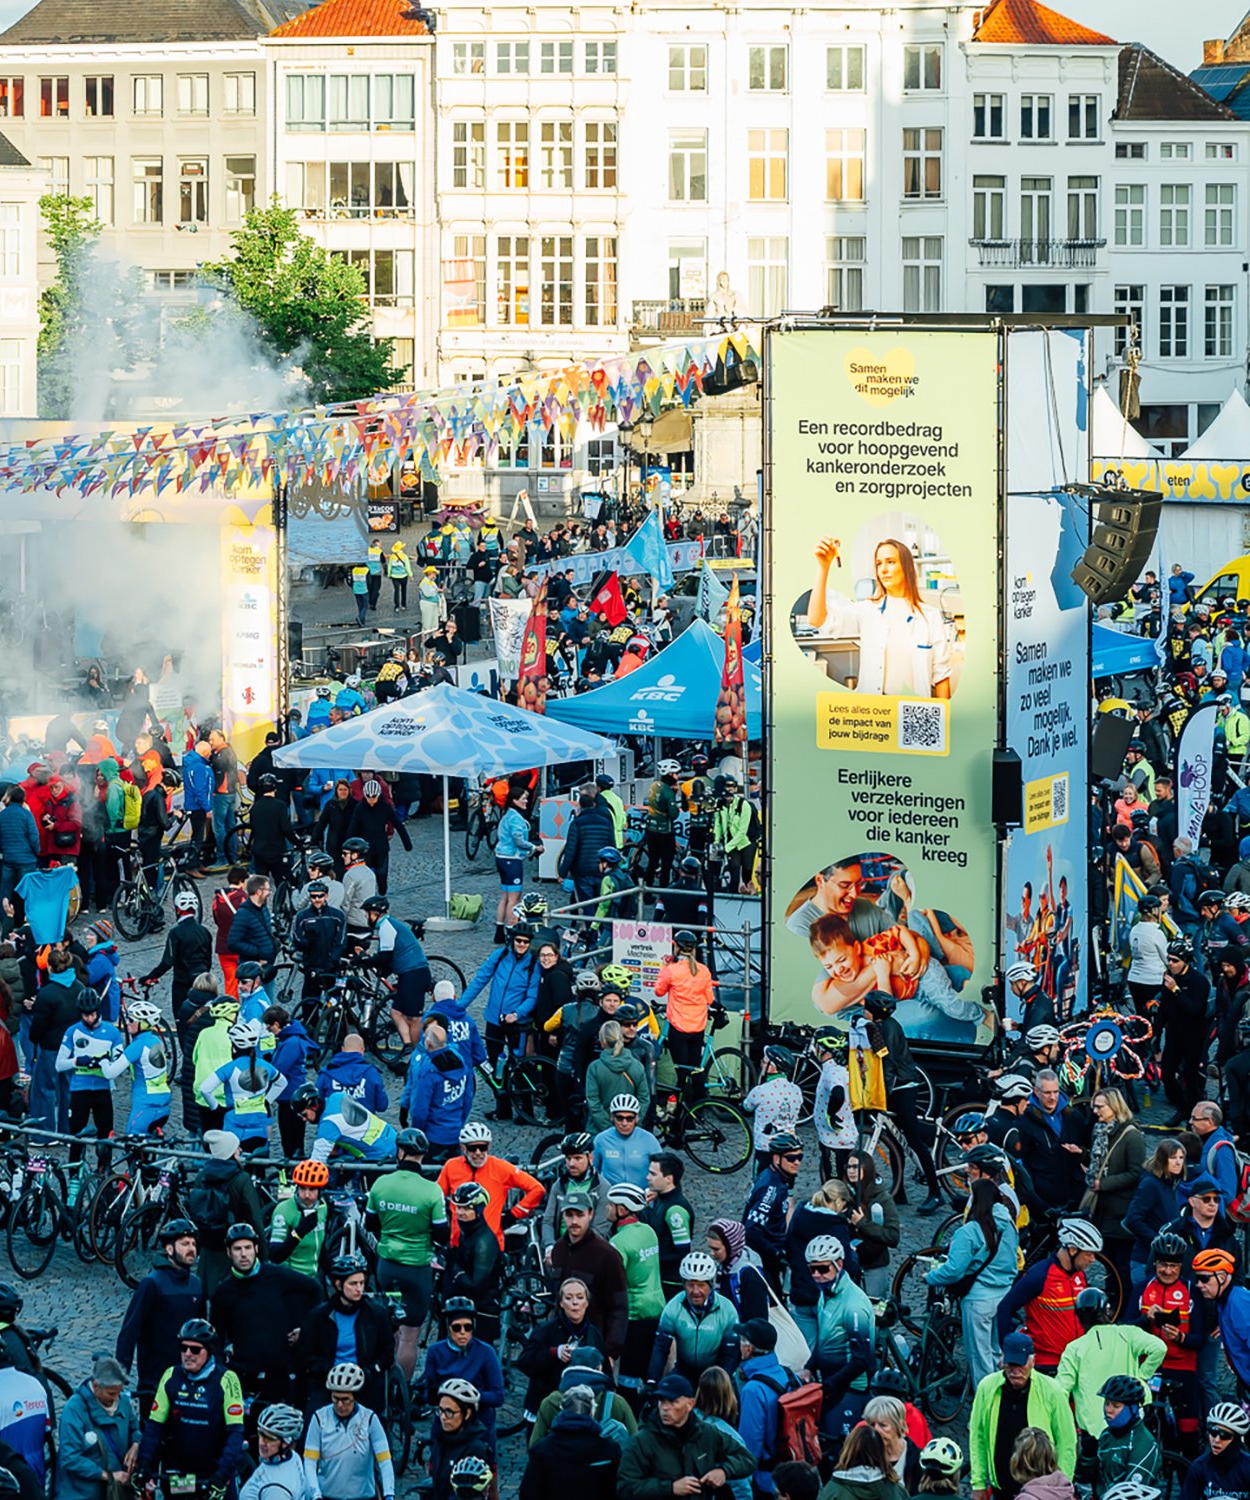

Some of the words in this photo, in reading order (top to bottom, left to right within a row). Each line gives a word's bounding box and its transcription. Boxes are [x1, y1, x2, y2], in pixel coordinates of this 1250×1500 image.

[849, 362, 887, 374] Samen
[866, 374, 902, 384] maken
[903, 375, 920, 385] we
[854, 383, 868, 393] dit
[870, 385, 916, 398] mogelijk
[799, 420, 828, 434] Een
[833, 421, 943, 441] recordbedrag
[818, 441, 854, 454] voor
[858, 440, 959, 459] hoopgevend
[806, 458, 947, 477] kankeronderzoek
[835, 481, 855, 493] en
[859, 481, 973, 500] zorgprojecten
[1167, 475, 1191, 487] eten
[1016, 641, 1047, 664] Samen
[1028, 661, 1058, 685] maken
[1059, 659, 1072, 677] we
[629, 691, 683, 702] KBC
[1020, 693, 1031, 711] zo
[1033, 684, 1051, 708] veel
[829, 704, 849, 714] Lees
[851, 705, 871, 715] alles
[872, 708, 892, 716] over
[1033, 701, 1072, 732] mogelijk.
[390, 716, 415, 724] kom
[629, 723, 656, 732] KBC
[828, 717, 841, 726] de
[843, 717, 873, 728] impact
[876, 719, 892, 728] van
[378, 728, 416, 737] kanker
[828, 728, 851, 739] jouw
[852, 729, 890, 742] bijdrage
[1027, 732, 1051, 758] Dank
[1051, 729, 1060, 758] je
[1061, 725, 1078, 748] wel.
[838, 769, 912, 789] Eerlijkere
[1192, 754, 1208, 801] HOOP
[851, 791, 965, 812] verzekeringen
[848, 809, 884, 823] voor
[888, 809, 959, 828] iedereen
[866, 827, 891, 842] die
[895, 828, 951, 846] kanker
[922, 846, 968, 867] kreeg
[627, 950, 658, 959] Mechelen
[387, 1202, 418, 1215] DEME
